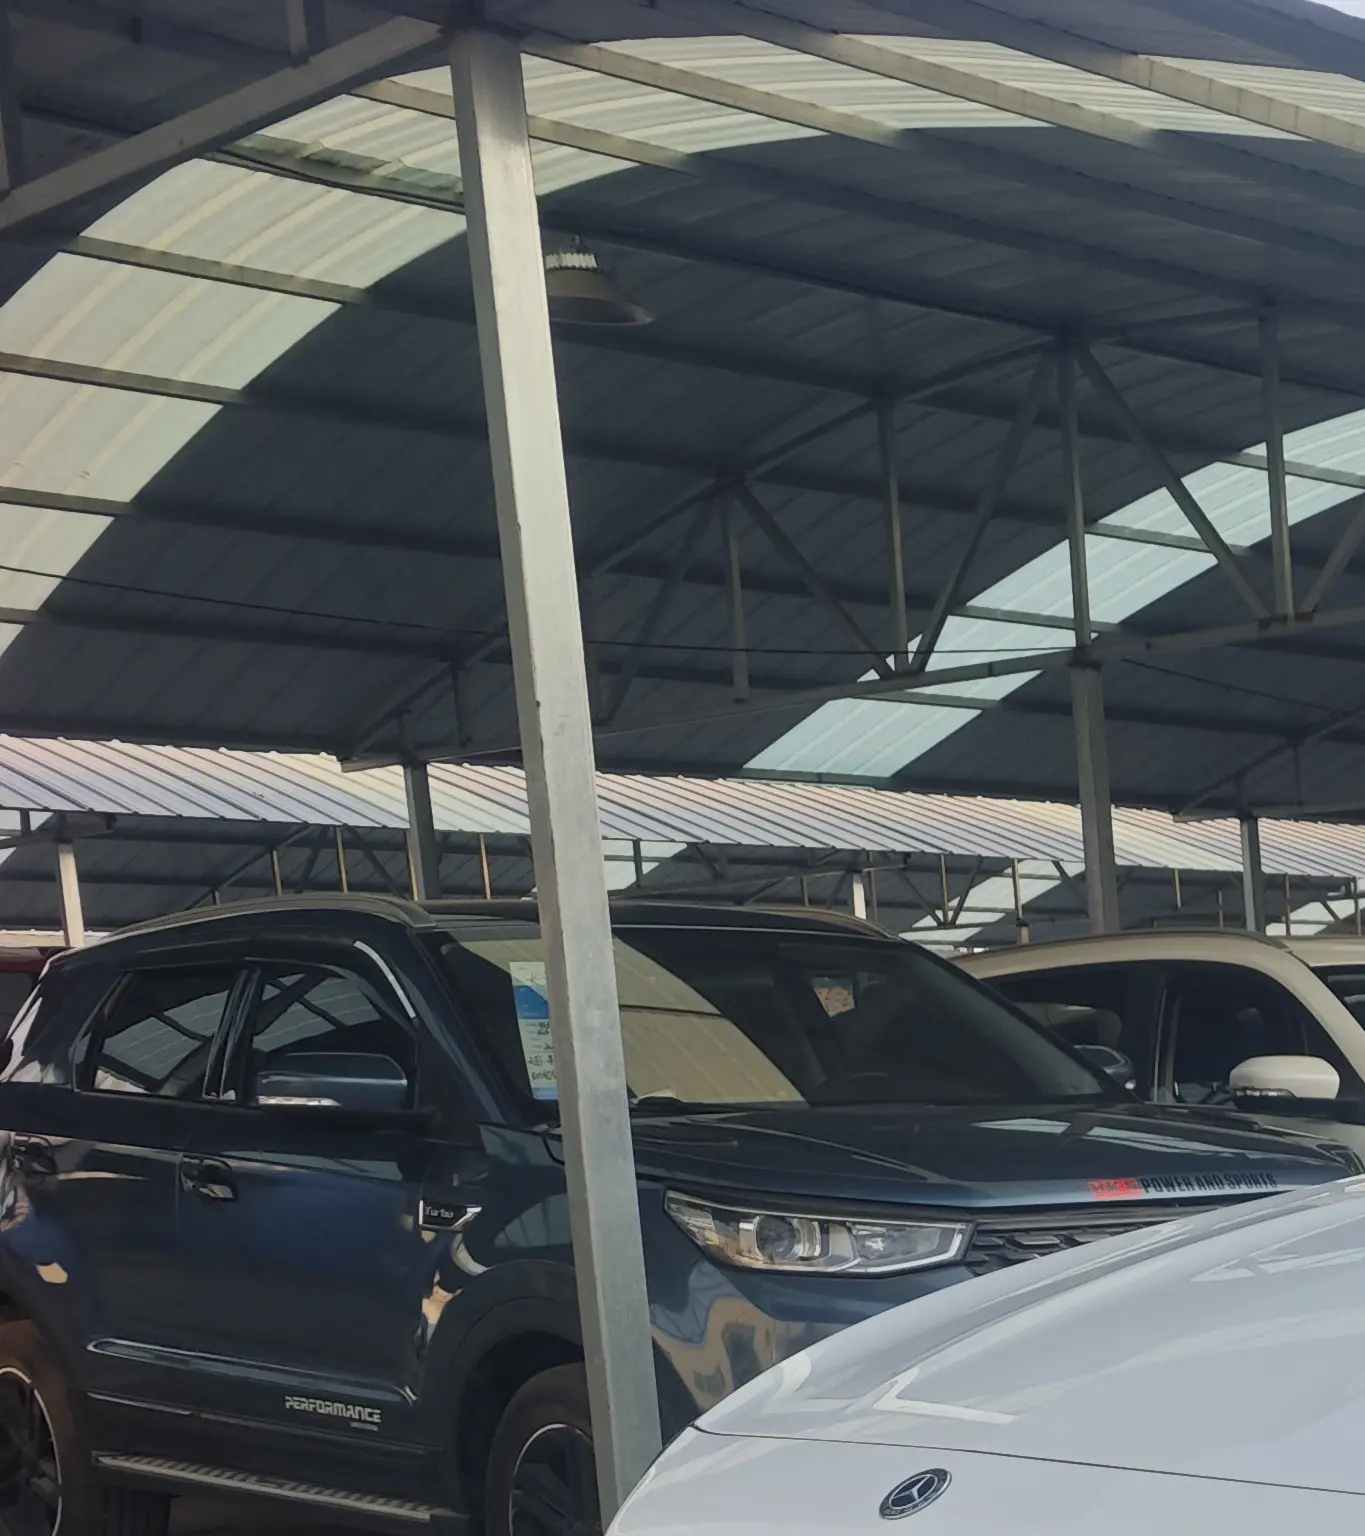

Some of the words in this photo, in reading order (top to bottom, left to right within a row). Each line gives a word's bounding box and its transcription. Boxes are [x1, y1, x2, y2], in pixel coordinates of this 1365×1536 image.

[1139, 1174, 1196, 1193] POWER
[1195, 1173, 1226, 1191] AND
[1225, 1171, 1279, 1189] SPORTS
[284, 1395, 382, 1422] PERFORMANCE
